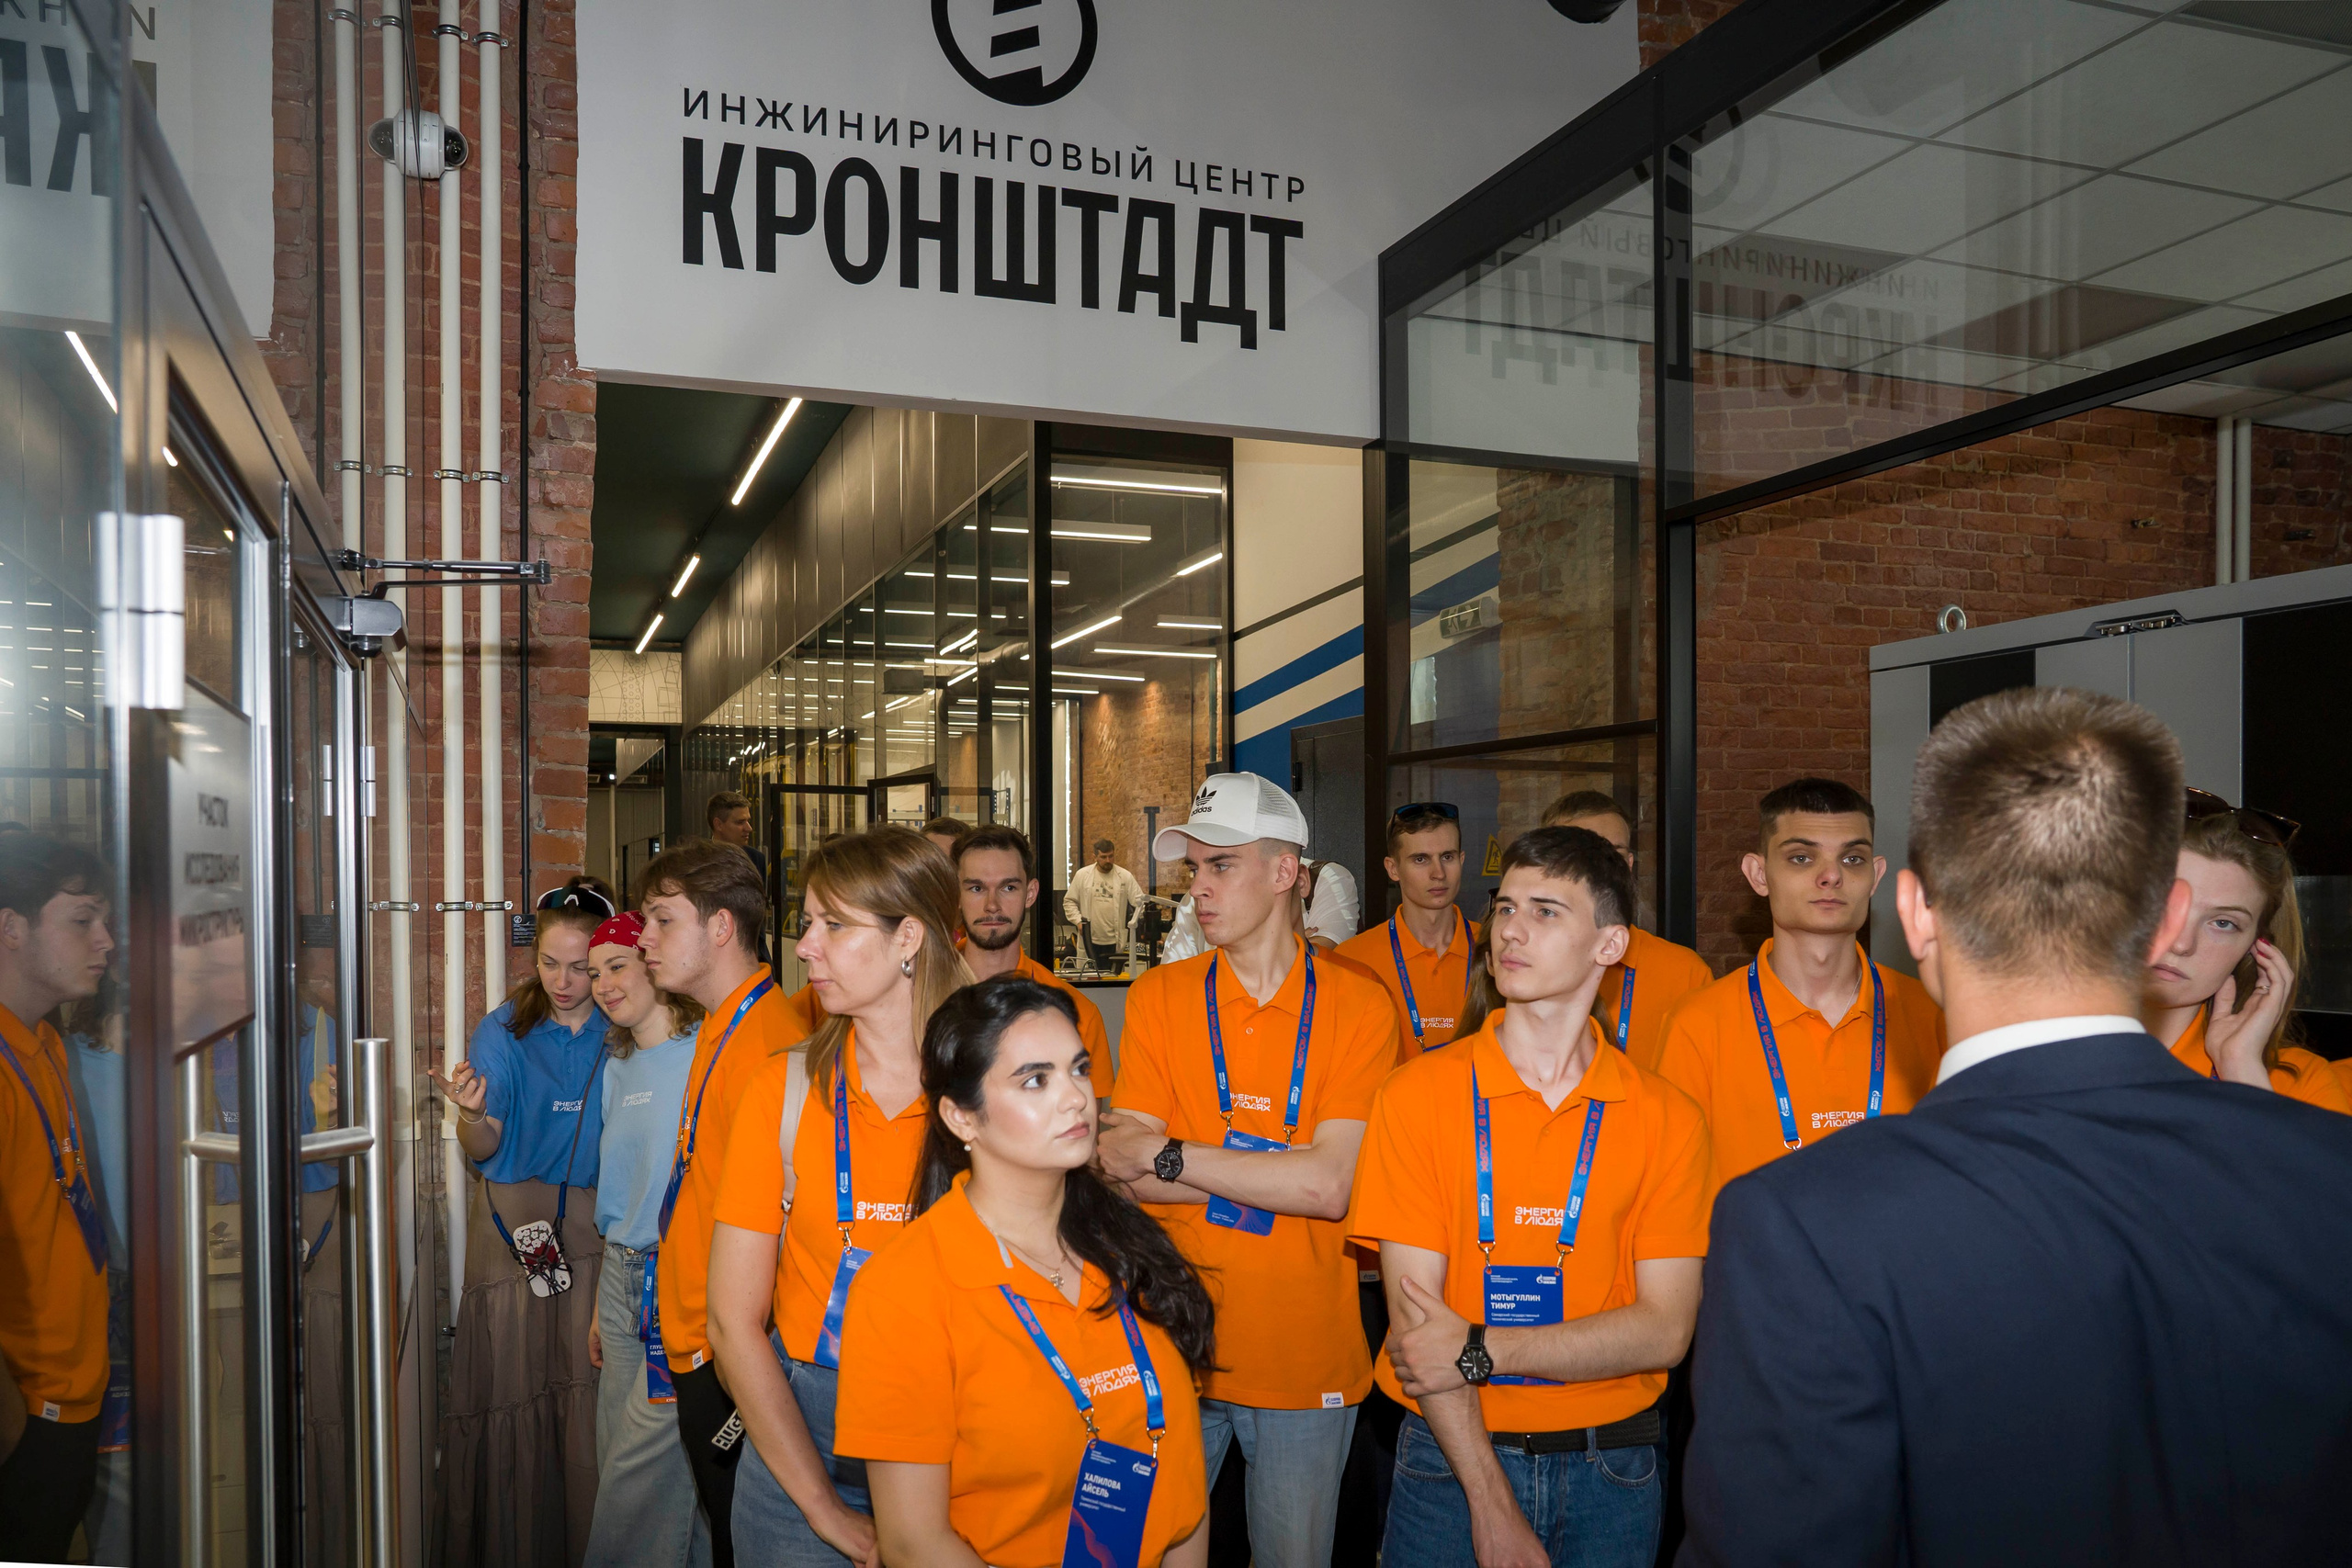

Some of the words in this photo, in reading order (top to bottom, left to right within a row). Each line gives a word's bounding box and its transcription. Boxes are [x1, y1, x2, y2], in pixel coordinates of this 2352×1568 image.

[684, 87, 1152, 183] ИНЖИНИРИНГОВЫЙ
[1175, 160, 1306, 203] ЦЕНТР
[683, 137, 1304, 350] КРОНШТАДТ
[1234, 1101, 1271, 1111] ЛЮДЯХ
[1811, 1111, 1865, 1121] ЭНЕРГИЯ
[1812, 1121, 1821, 1129] В
[1823, 1119, 1861, 1128] ЛЮДЯ
[1478, 1128, 1489, 1173] ЛЮДЯХ
[1577, 1122, 1598, 1176] ЭНЕРГИЯ
[856, 1201, 912, 1213] ЭНЕРГИ
[1515, 1206, 1565, 1218] ЭНЕРГИ
[855, 1210, 866, 1220] В
[867, 1211, 910, 1222] ЛЮДЯ
[1514, 1215, 1522, 1224] В
[1524, 1216, 1564, 1226] ЛЮДЯ
[1490, 1293, 1541, 1302] МОТЫГУЛЛИН
[1490, 1302, 1516, 1310] ТИМУР
[1079, 1363, 1138, 1388] ЭНЕРГИЯ
[1093, 1372, 1141, 1397] ЛЮДЯХ
[711, 1412, 742, 1450] HUG
[1084, 1472, 1121, 1490] ХАЛИЛОВА
[1081, 1483, 1109, 1498] АЙСЕЛЬ
